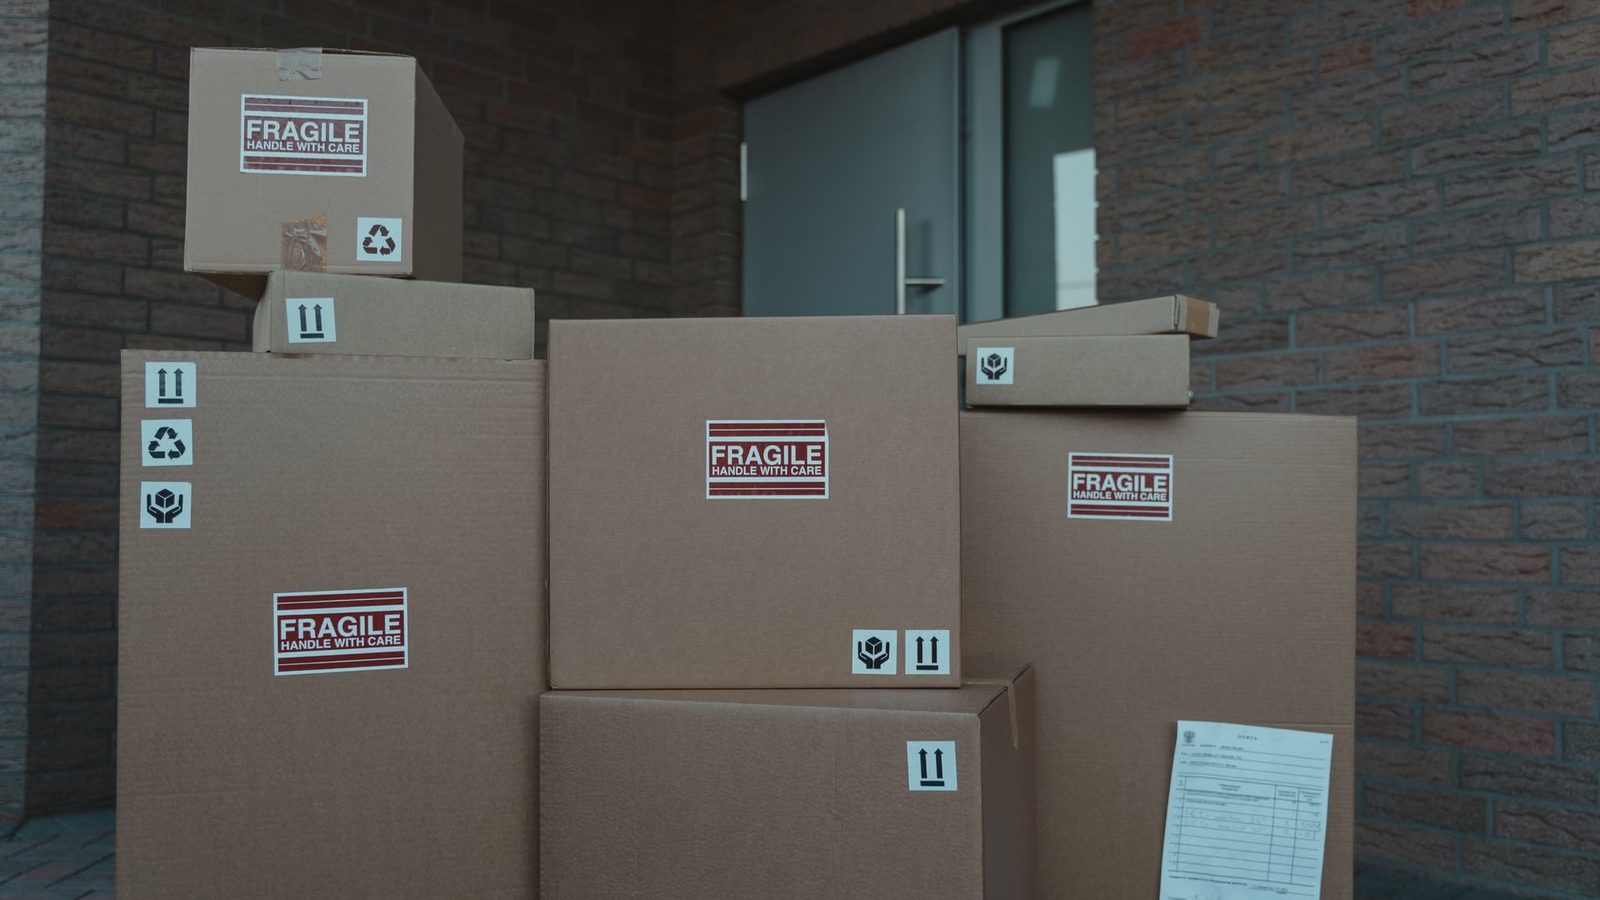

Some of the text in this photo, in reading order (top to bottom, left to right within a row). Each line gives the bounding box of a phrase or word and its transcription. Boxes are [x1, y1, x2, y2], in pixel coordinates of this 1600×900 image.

[246, 119, 361, 143] FRAGILE
[247, 140, 360, 153] HANDLE WITH CARE
[711, 445, 822, 465] FRAGILE
[712, 466, 822, 475] HANDLE WITH CARE
[1073, 473, 1168, 492] FRAGILE
[1073, 490, 1167, 501] HANDLE WITH CARE
[280, 614, 401, 640] FRAGILE
[281, 635, 401, 650] HANDLE WITH CARE
